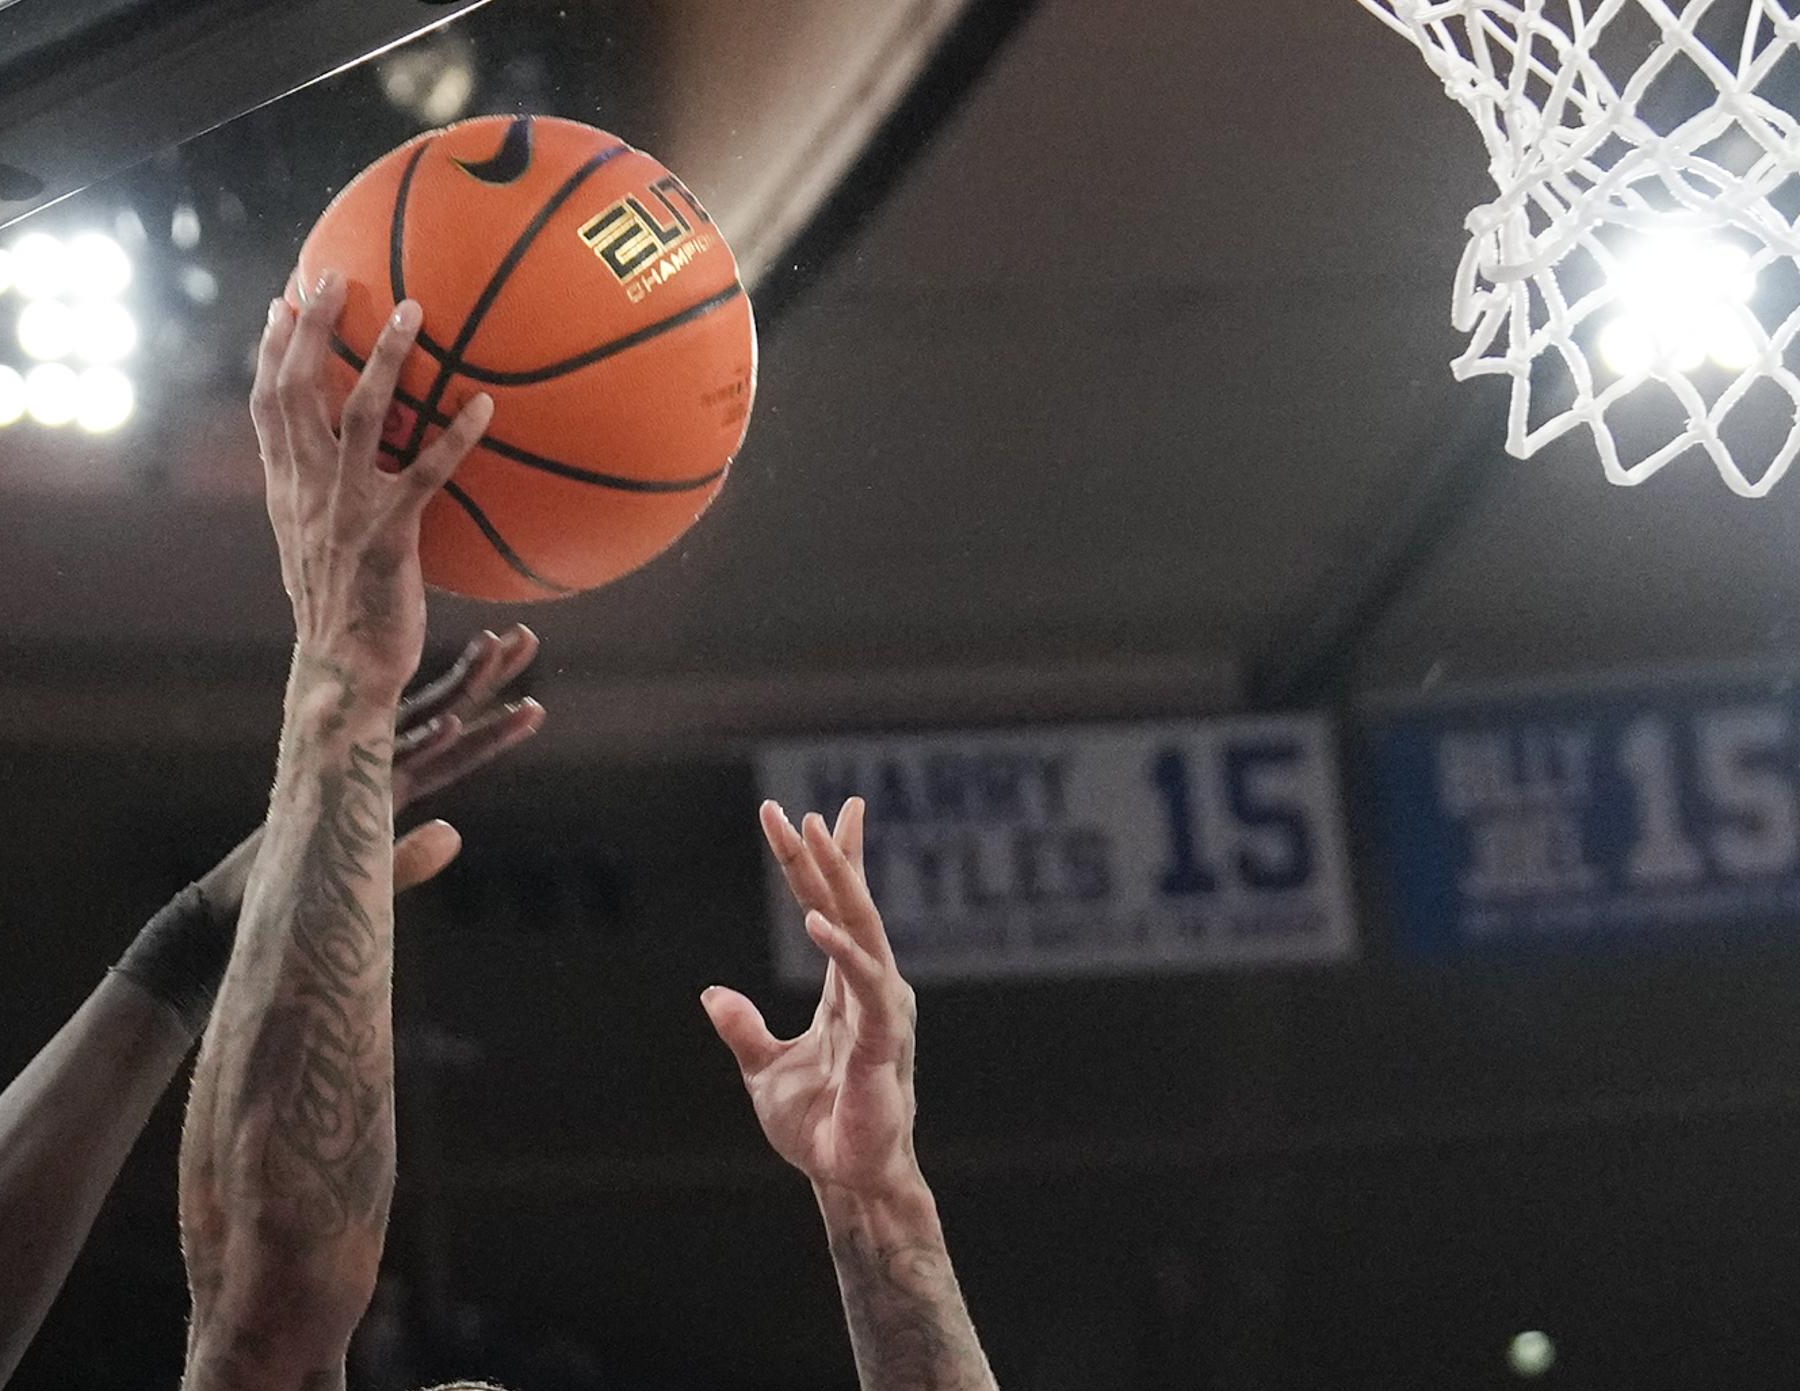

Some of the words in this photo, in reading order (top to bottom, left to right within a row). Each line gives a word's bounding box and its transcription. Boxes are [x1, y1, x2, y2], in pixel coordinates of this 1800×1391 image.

[578, 176, 711, 284] ELIT
[1151, 741, 1315, 895] 15
[1621, 710, 1796, 878] 15
[862, 824, 1111, 908] TYLES
